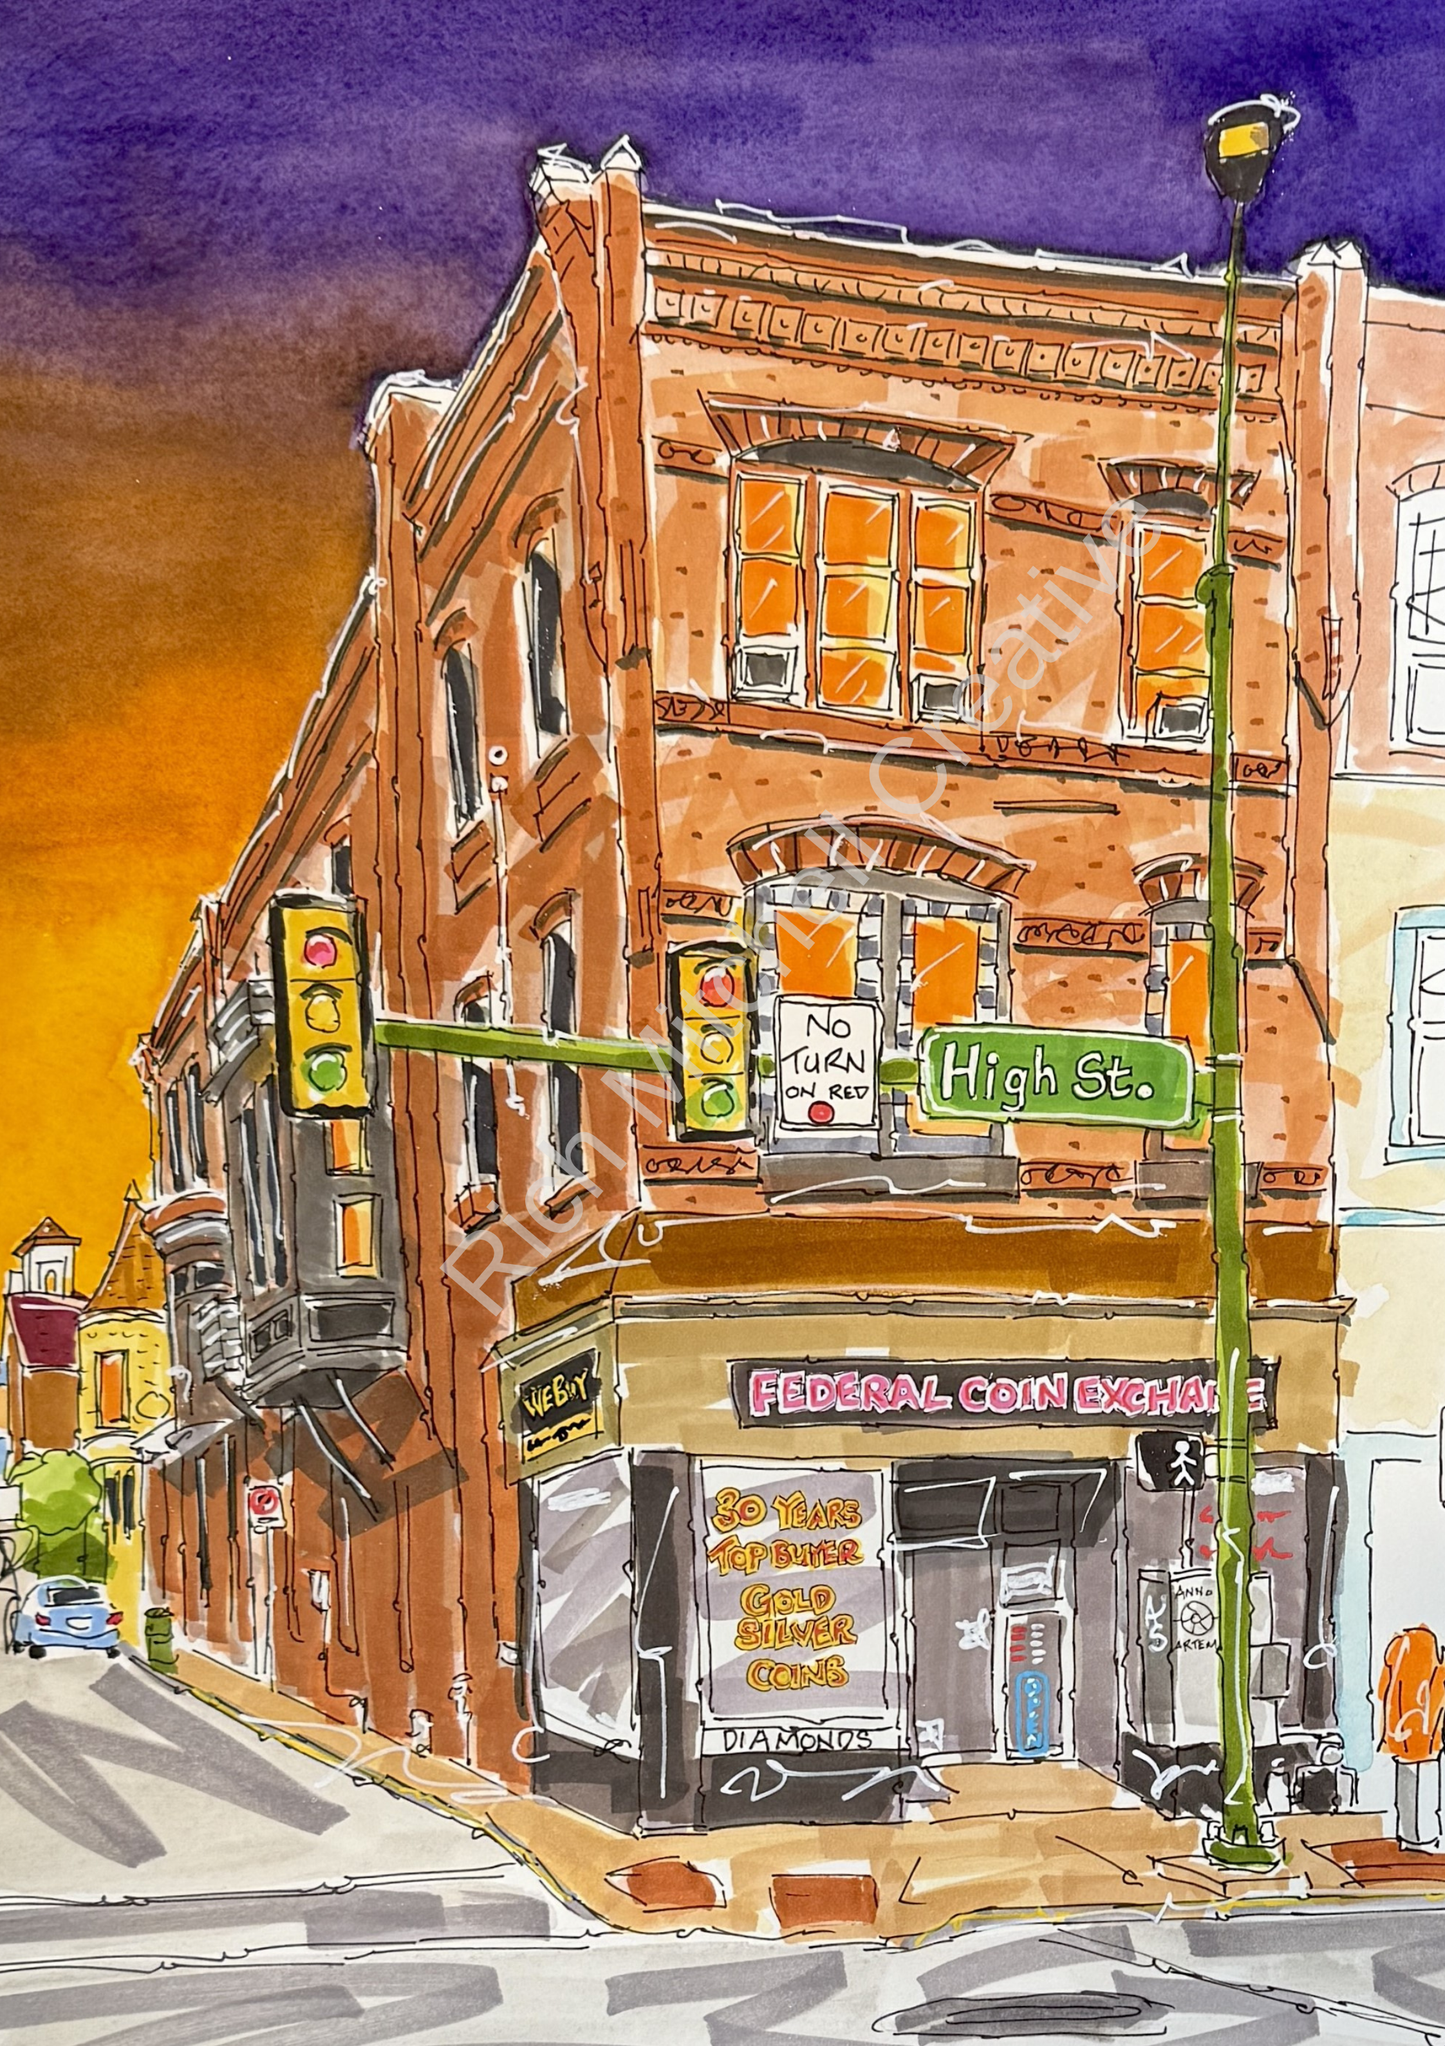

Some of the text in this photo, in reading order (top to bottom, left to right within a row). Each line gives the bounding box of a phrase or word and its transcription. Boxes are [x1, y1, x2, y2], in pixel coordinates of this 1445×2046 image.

[806, 1006, 851, 1039] NO
[781, 1046, 865, 1074] TURN
[940, 1041, 1155, 1112] High St.
[785, 1082, 870, 1100] ON RED
[750, 1368, 1267, 1417] FEDERAL COIN EXCHAE
[711, 1487, 862, 1533] 30 YEARS
[707, 1535, 865, 1576] TOP BUYER
[740, 1583, 836, 1617] GOLD
[734, 1614, 858, 1651] SILVER
[746, 1655, 849, 1691] COINS
[724, 1729, 872, 1751] DIAMONDS
